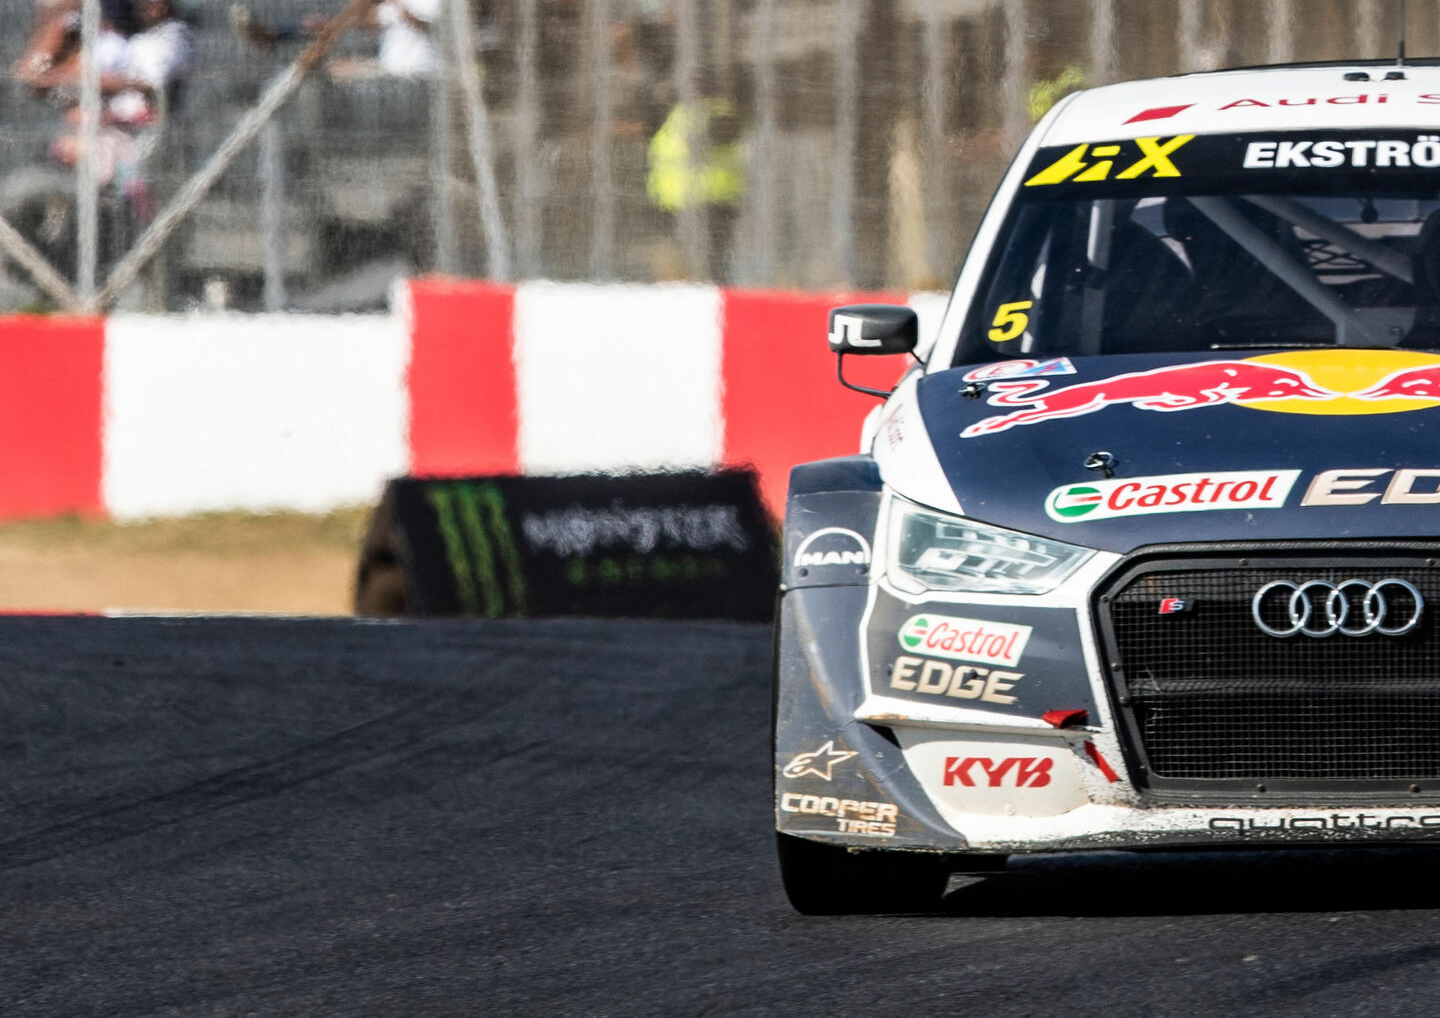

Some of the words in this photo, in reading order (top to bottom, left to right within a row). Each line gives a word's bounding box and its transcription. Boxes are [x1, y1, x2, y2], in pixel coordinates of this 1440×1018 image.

[1218, 93, 1388, 111] Audi
[986, 300, 1034, 342] 5
[1107, 474, 1279, 512] Castrol
[925, 621, 1019, 661] Castrol
[890, 656, 1025, 704] EDGE
[943, 756, 1055, 789] KYB
[781, 792, 899, 823] COOPER
[835, 818, 897, 837] TIRES
